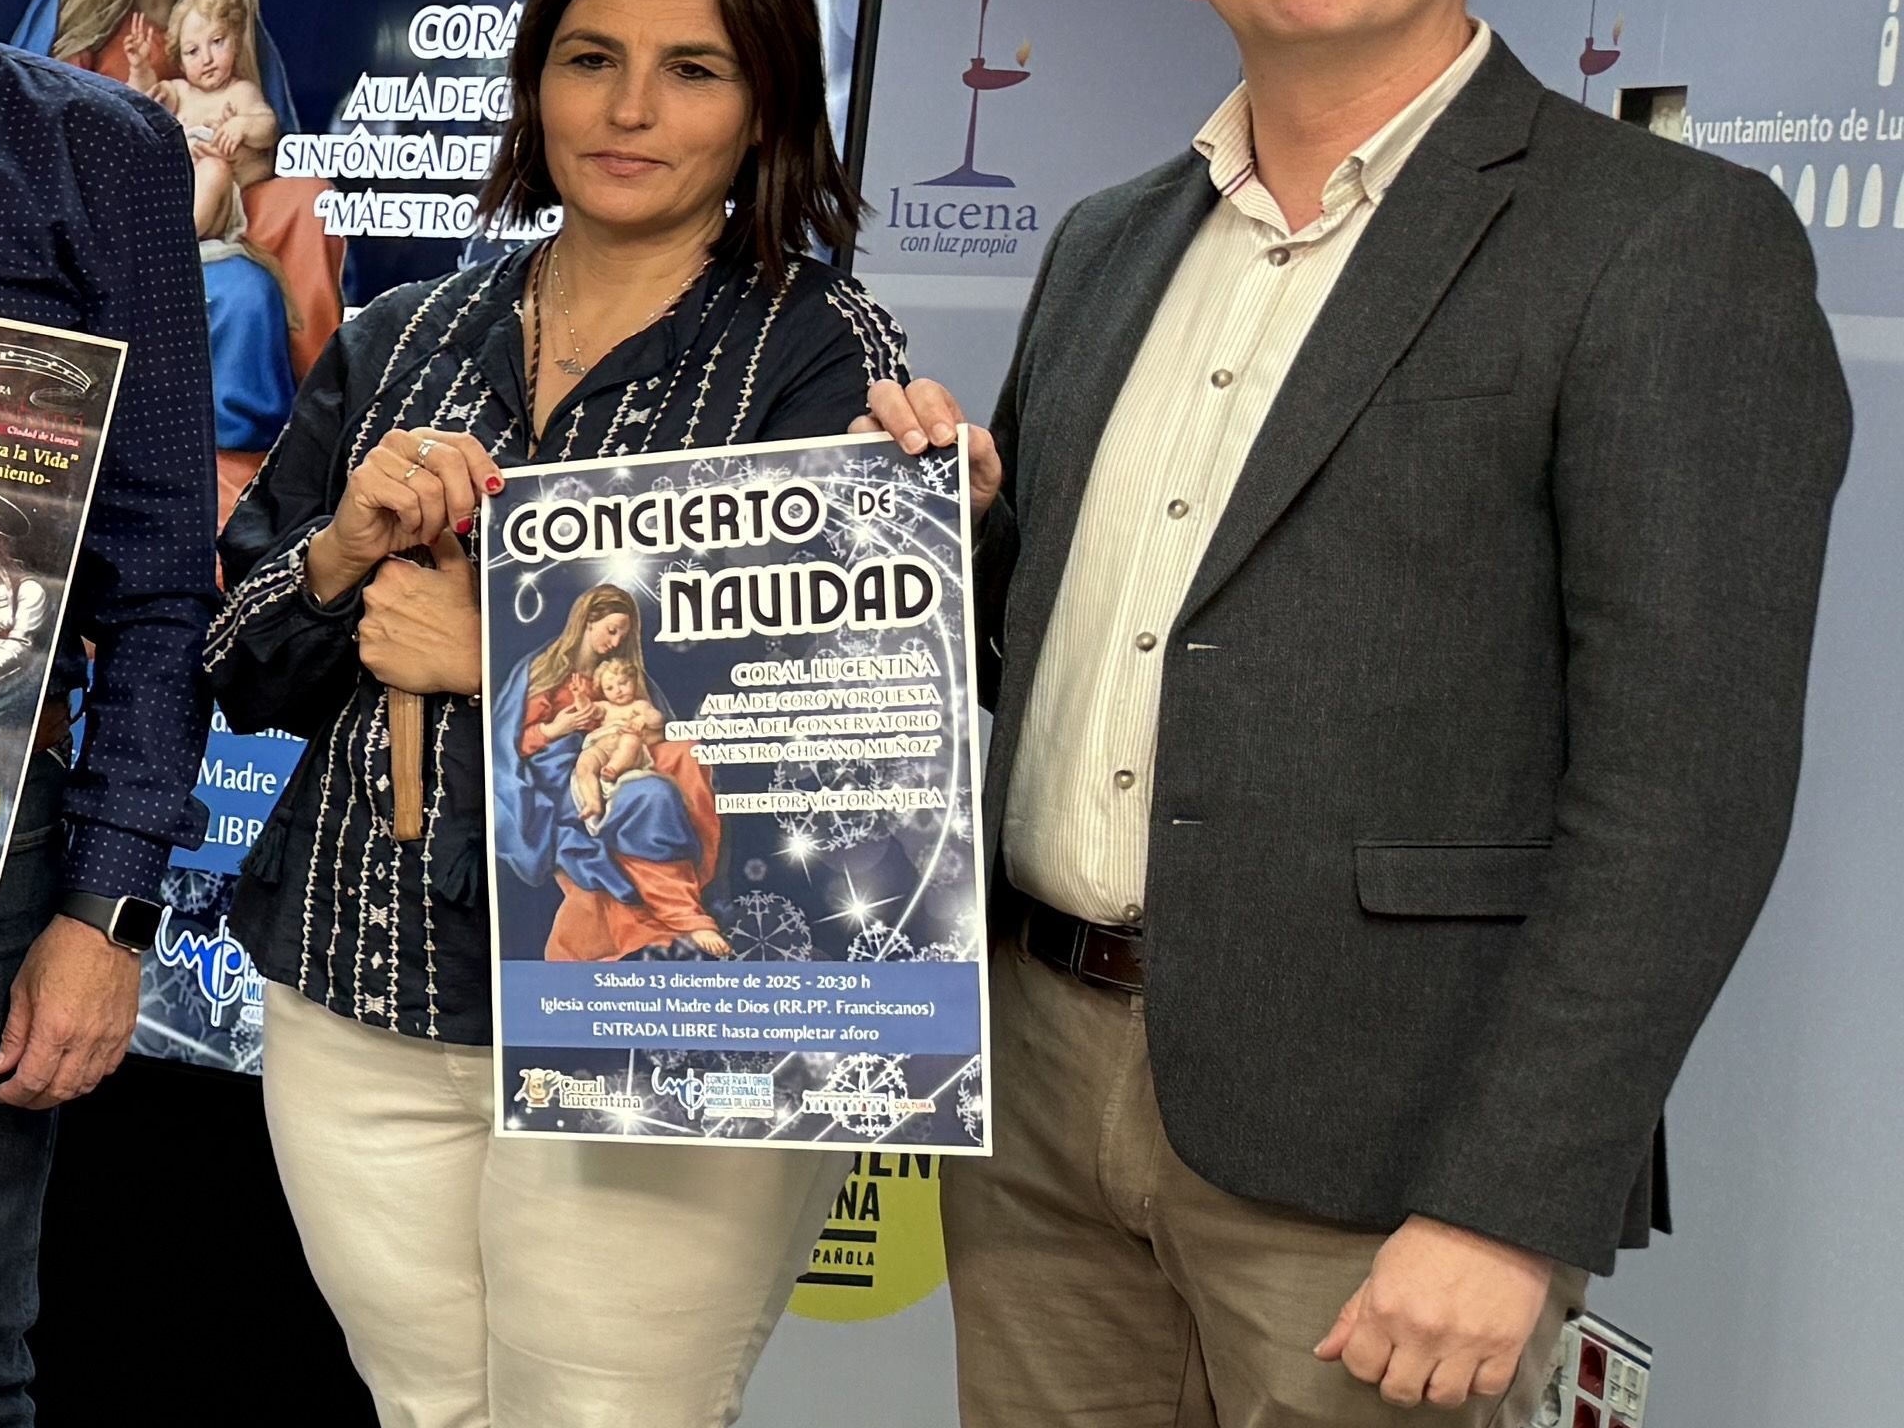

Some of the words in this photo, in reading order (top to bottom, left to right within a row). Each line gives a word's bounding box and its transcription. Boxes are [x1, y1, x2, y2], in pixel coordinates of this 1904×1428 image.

[414, 12, 519, 51] CORA
[351, 81, 433, 113] AULA
[439, 84, 478, 113] DE
[1681, 110, 1833, 149] Ayuntamiento
[1840, 107, 1869, 142] de
[280, 130, 441, 172] SINFÓNICA
[447, 140, 492, 173] DE
[886, 187, 1039, 231] lucena
[900, 236, 930, 252] con
[933, 232, 960, 252] luz
[960, 233, 1017, 258] propia
[7, 425, 38, 440] Ciudad
[13, 444, 28, 461] la
[510, 486, 820, 556] CONCIERTO
[858, 488, 892, 515] DE
[670, 563, 934, 633] NAVIDAD
[734, 661, 808, 685] CORAL
[813, 653, 940, 680] LUCENTINA
[703, 694, 750, 713] AULA
[752, 694, 774, 710] DE
[779, 692, 829, 709] CORO
[829, 691, 844, 707] Y
[846, 686, 940, 706] ORQUESTA
[667, 717, 759, 738] SINFÓNICA
[762, 719, 794, 734] DEL
[795, 712, 939, 733] CONSERVATORIO
[785, 740, 863, 758] CHICANO
[197, 756, 277, 795] Madre
[717, 796, 808, 812] DIRECTOR:
[808, 789, 873, 807] VÍCTOR
[875, 786, 944, 806] NÁJERA
[594, 974, 645, 988] Sábado
[649, 975, 666, 989] 13
[670, 974, 739, 989] diciembre
[743, 974, 761, 989] de
[765, 975, 801, 990] 2025
[816, 976, 858, 990] 20:30
[861, 975, 871, 989] h
[541, 997, 584, 1014] Iglesia
[587, 998, 661, 1013] conventual
[665, 999, 711, 1013] Madre
[715, 999, 733, 1013] de
[737, 999, 769, 1014] Dios
[774, 1000, 832, 1016] (RR.PP.
[836, 1000, 935, 1017] Franciscanos)
[592, 1022, 668, 1037] ENTRADA
[672, 1023, 717, 1038] LIBRE
[722, 1024, 759, 1039] hasta
[763, 1025, 836, 1042] completar
[839, 1025, 879, 1040] aforo
[561, 1076, 605, 1094] Coral
[561, 1093, 641, 1108] Lucentina
[813, 1247, 875, 1266] PAÑOLA
